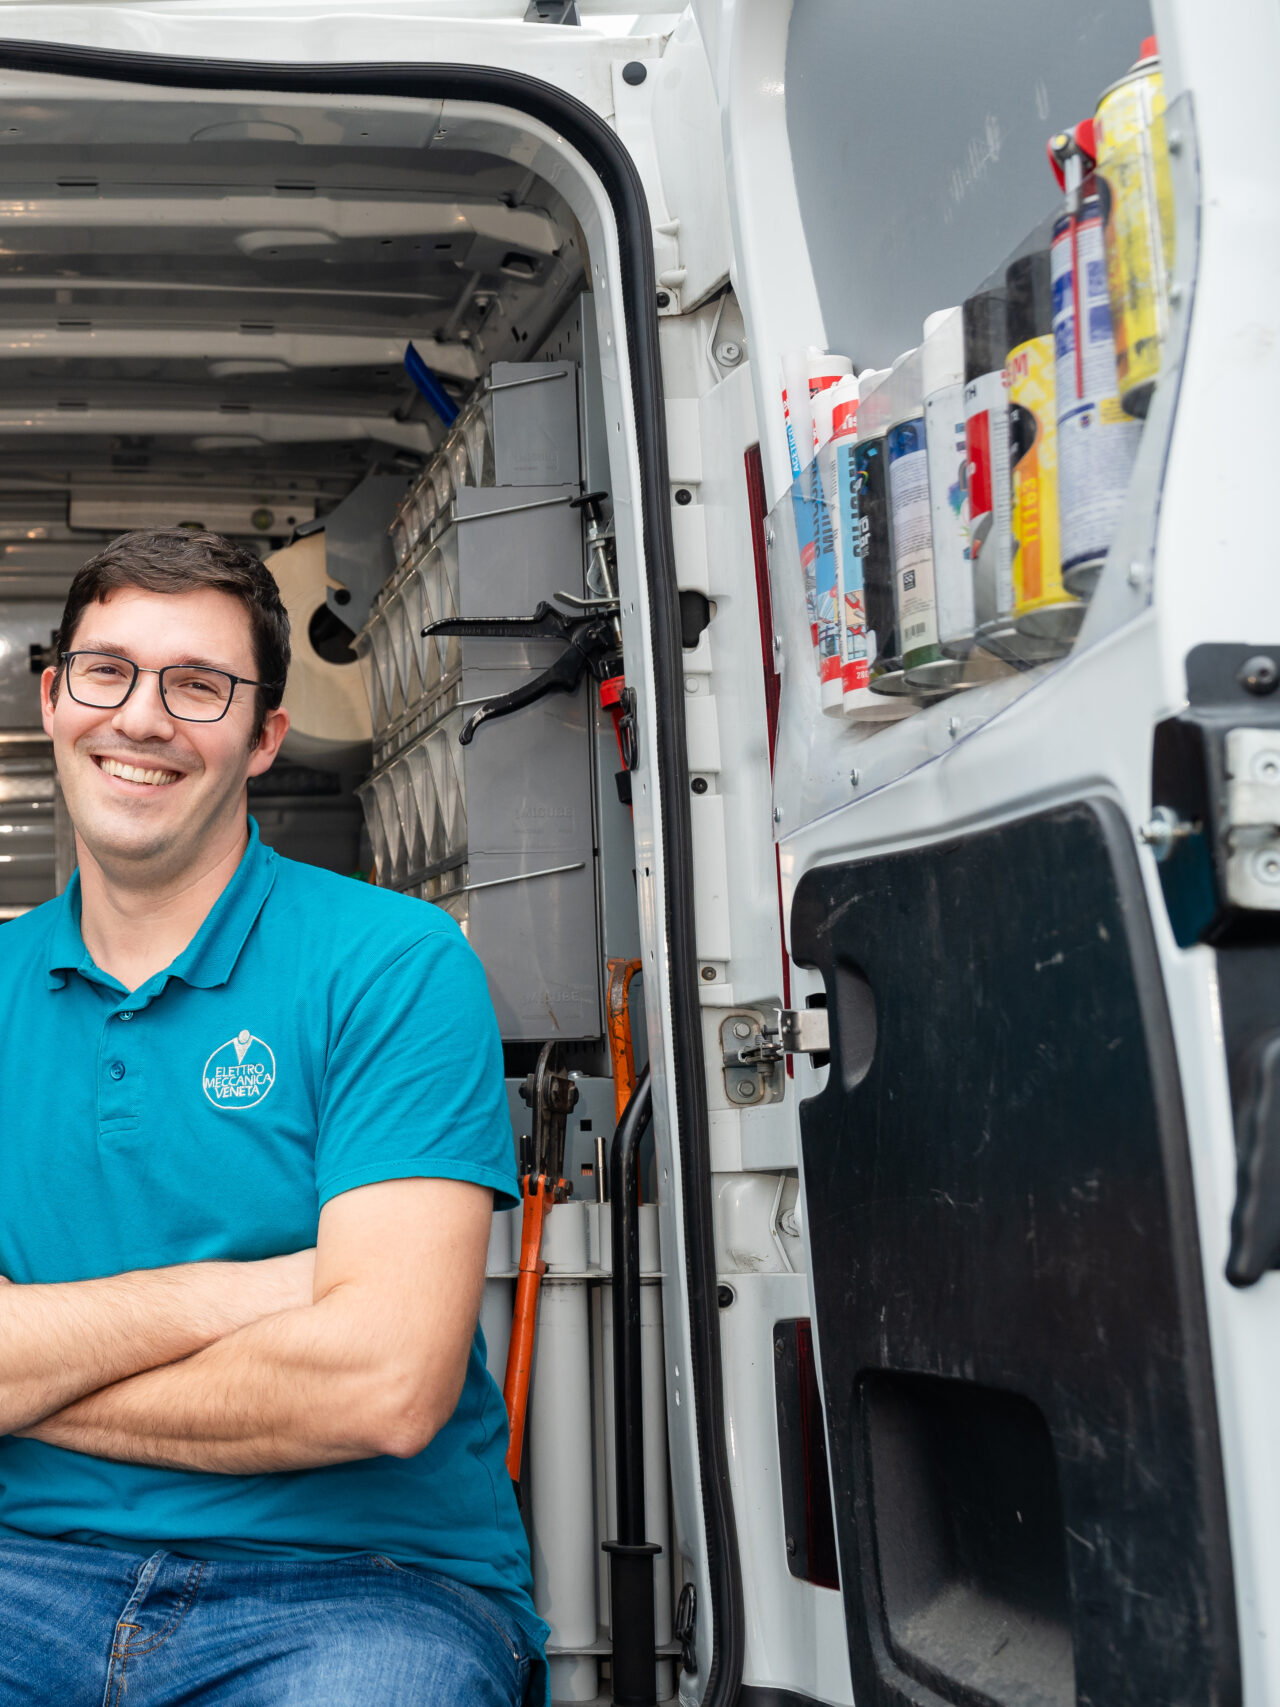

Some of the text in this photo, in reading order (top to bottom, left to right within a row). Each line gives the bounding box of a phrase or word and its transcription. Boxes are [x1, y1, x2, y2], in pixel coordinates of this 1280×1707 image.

[215, 1064, 264, 1077] ELETTRO
[205, 1073, 272, 1088] MECCANICA
[215, 1084, 260, 1098] VENETA
